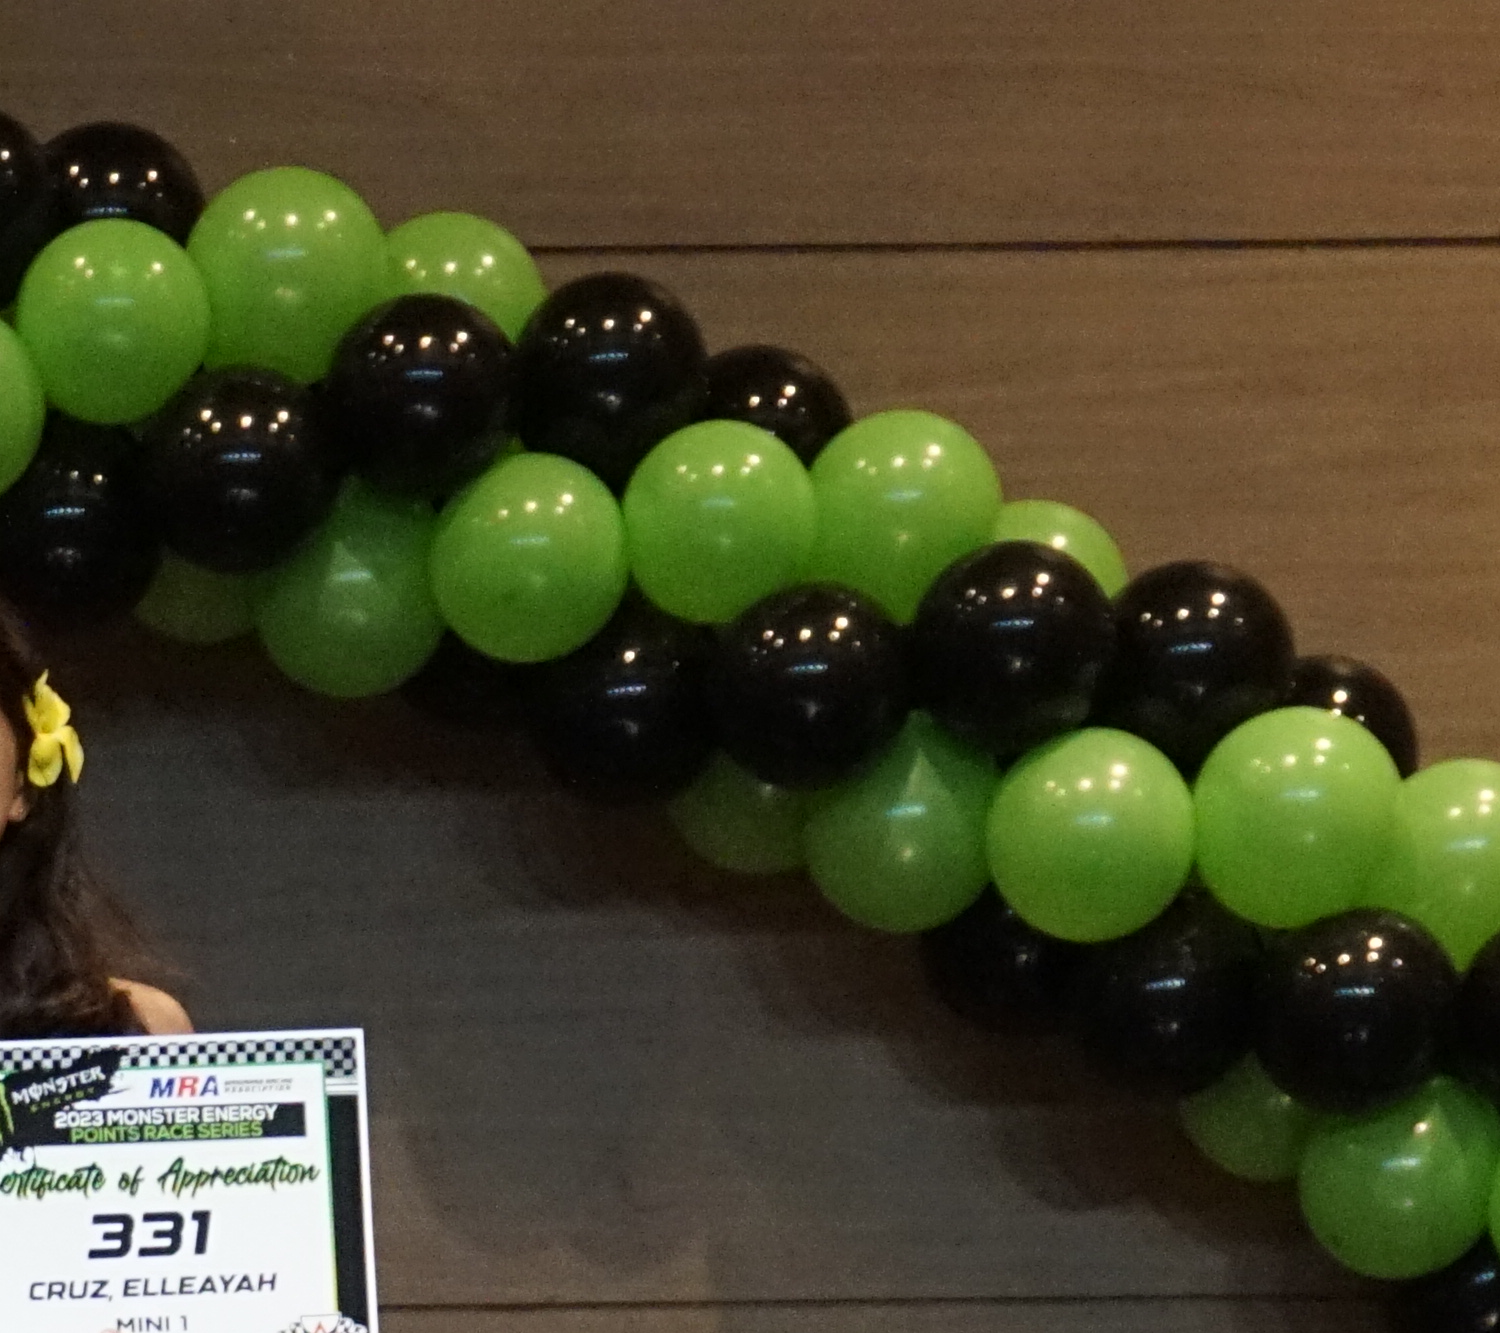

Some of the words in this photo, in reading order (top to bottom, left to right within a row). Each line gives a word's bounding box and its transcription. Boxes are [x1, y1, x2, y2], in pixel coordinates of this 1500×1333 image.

[11, 1065, 106, 1105] MONSTER
[150, 1075, 219, 1098] MRA
[54, 1110, 104, 1129] 2023
[107, 1106, 200, 1127] MONSTER
[202, 1104, 279, 1123] ENERGY
[70, 1126, 141, 1143] POINTS
[144, 1124, 194, 1141] RACE
[198, 1120, 264, 1139] SERIES
[118, 1166, 145, 1197] of
[158, 1155, 320, 1198] Appreciation
[88, 1210, 211, 1259] 331
[29, 1279, 114, 1302] CRUZ,
[123, 1273, 278, 1298] ELLEAYAH
[117, 1315, 171, 1332] MINI
[181, 1315, 189, 1331] 1
